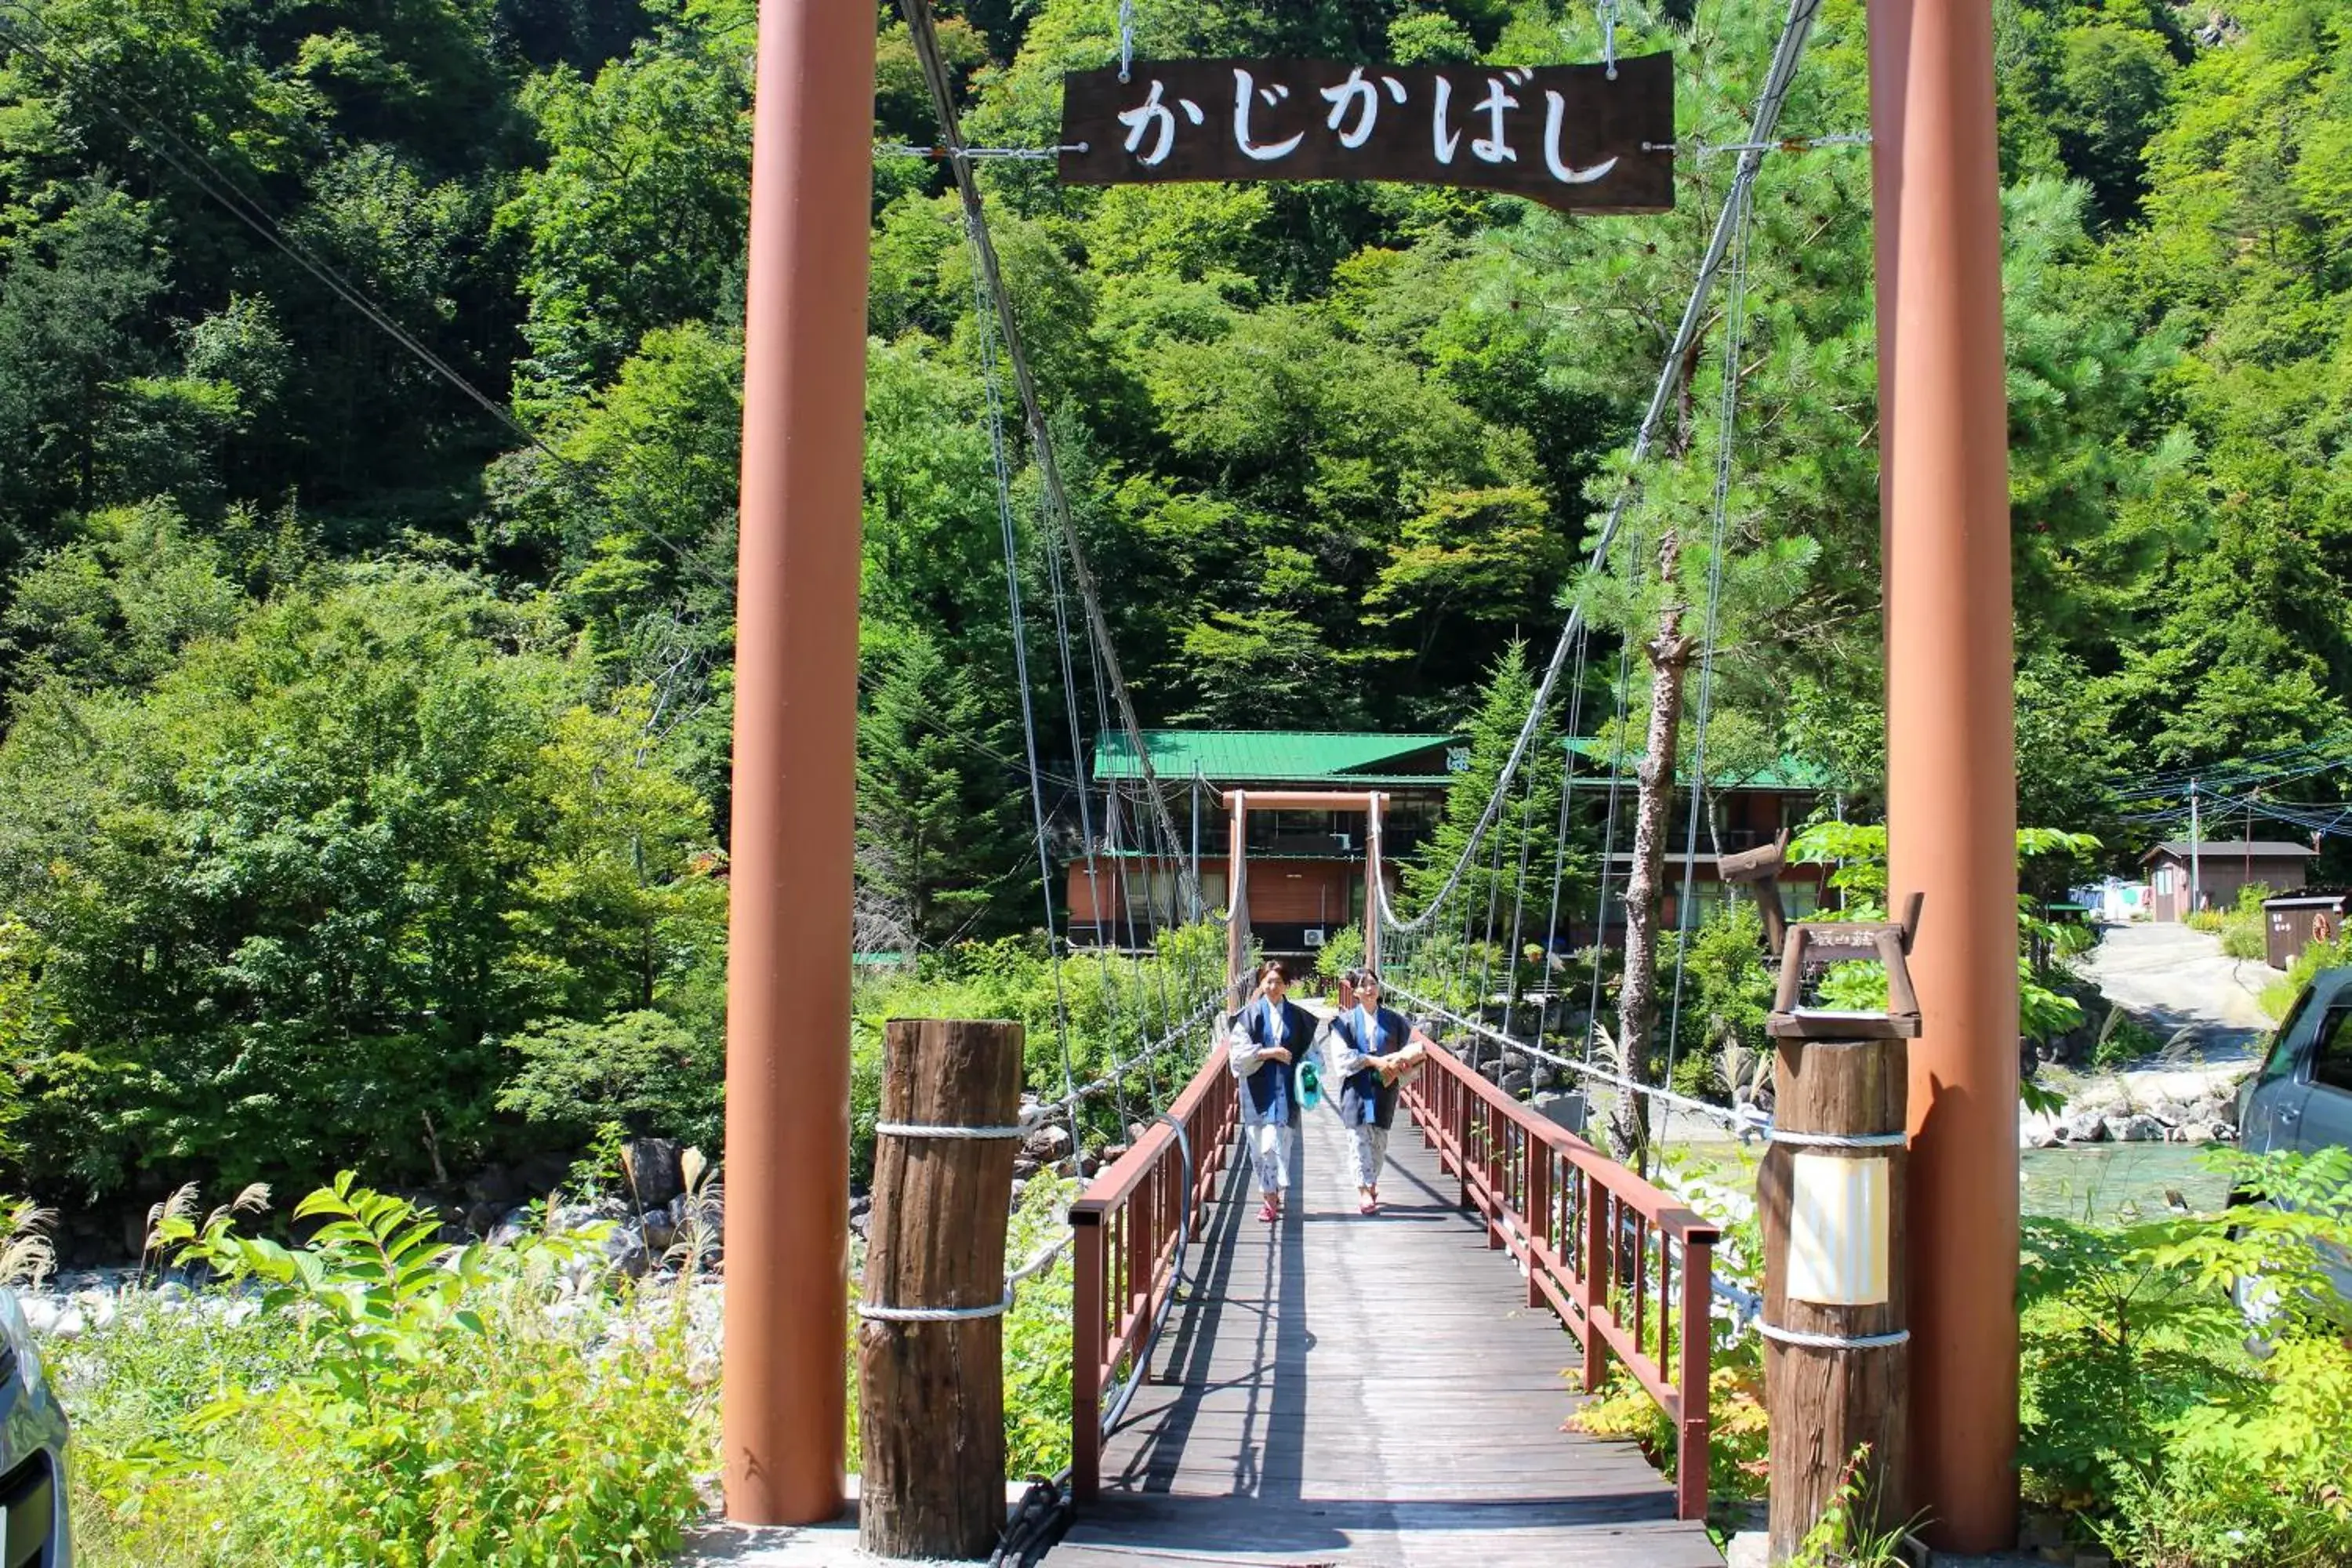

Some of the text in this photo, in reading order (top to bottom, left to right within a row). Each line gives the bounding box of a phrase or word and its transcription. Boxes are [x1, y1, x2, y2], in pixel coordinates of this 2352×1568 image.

[1117, 67, 1618, 183] かじかばし
